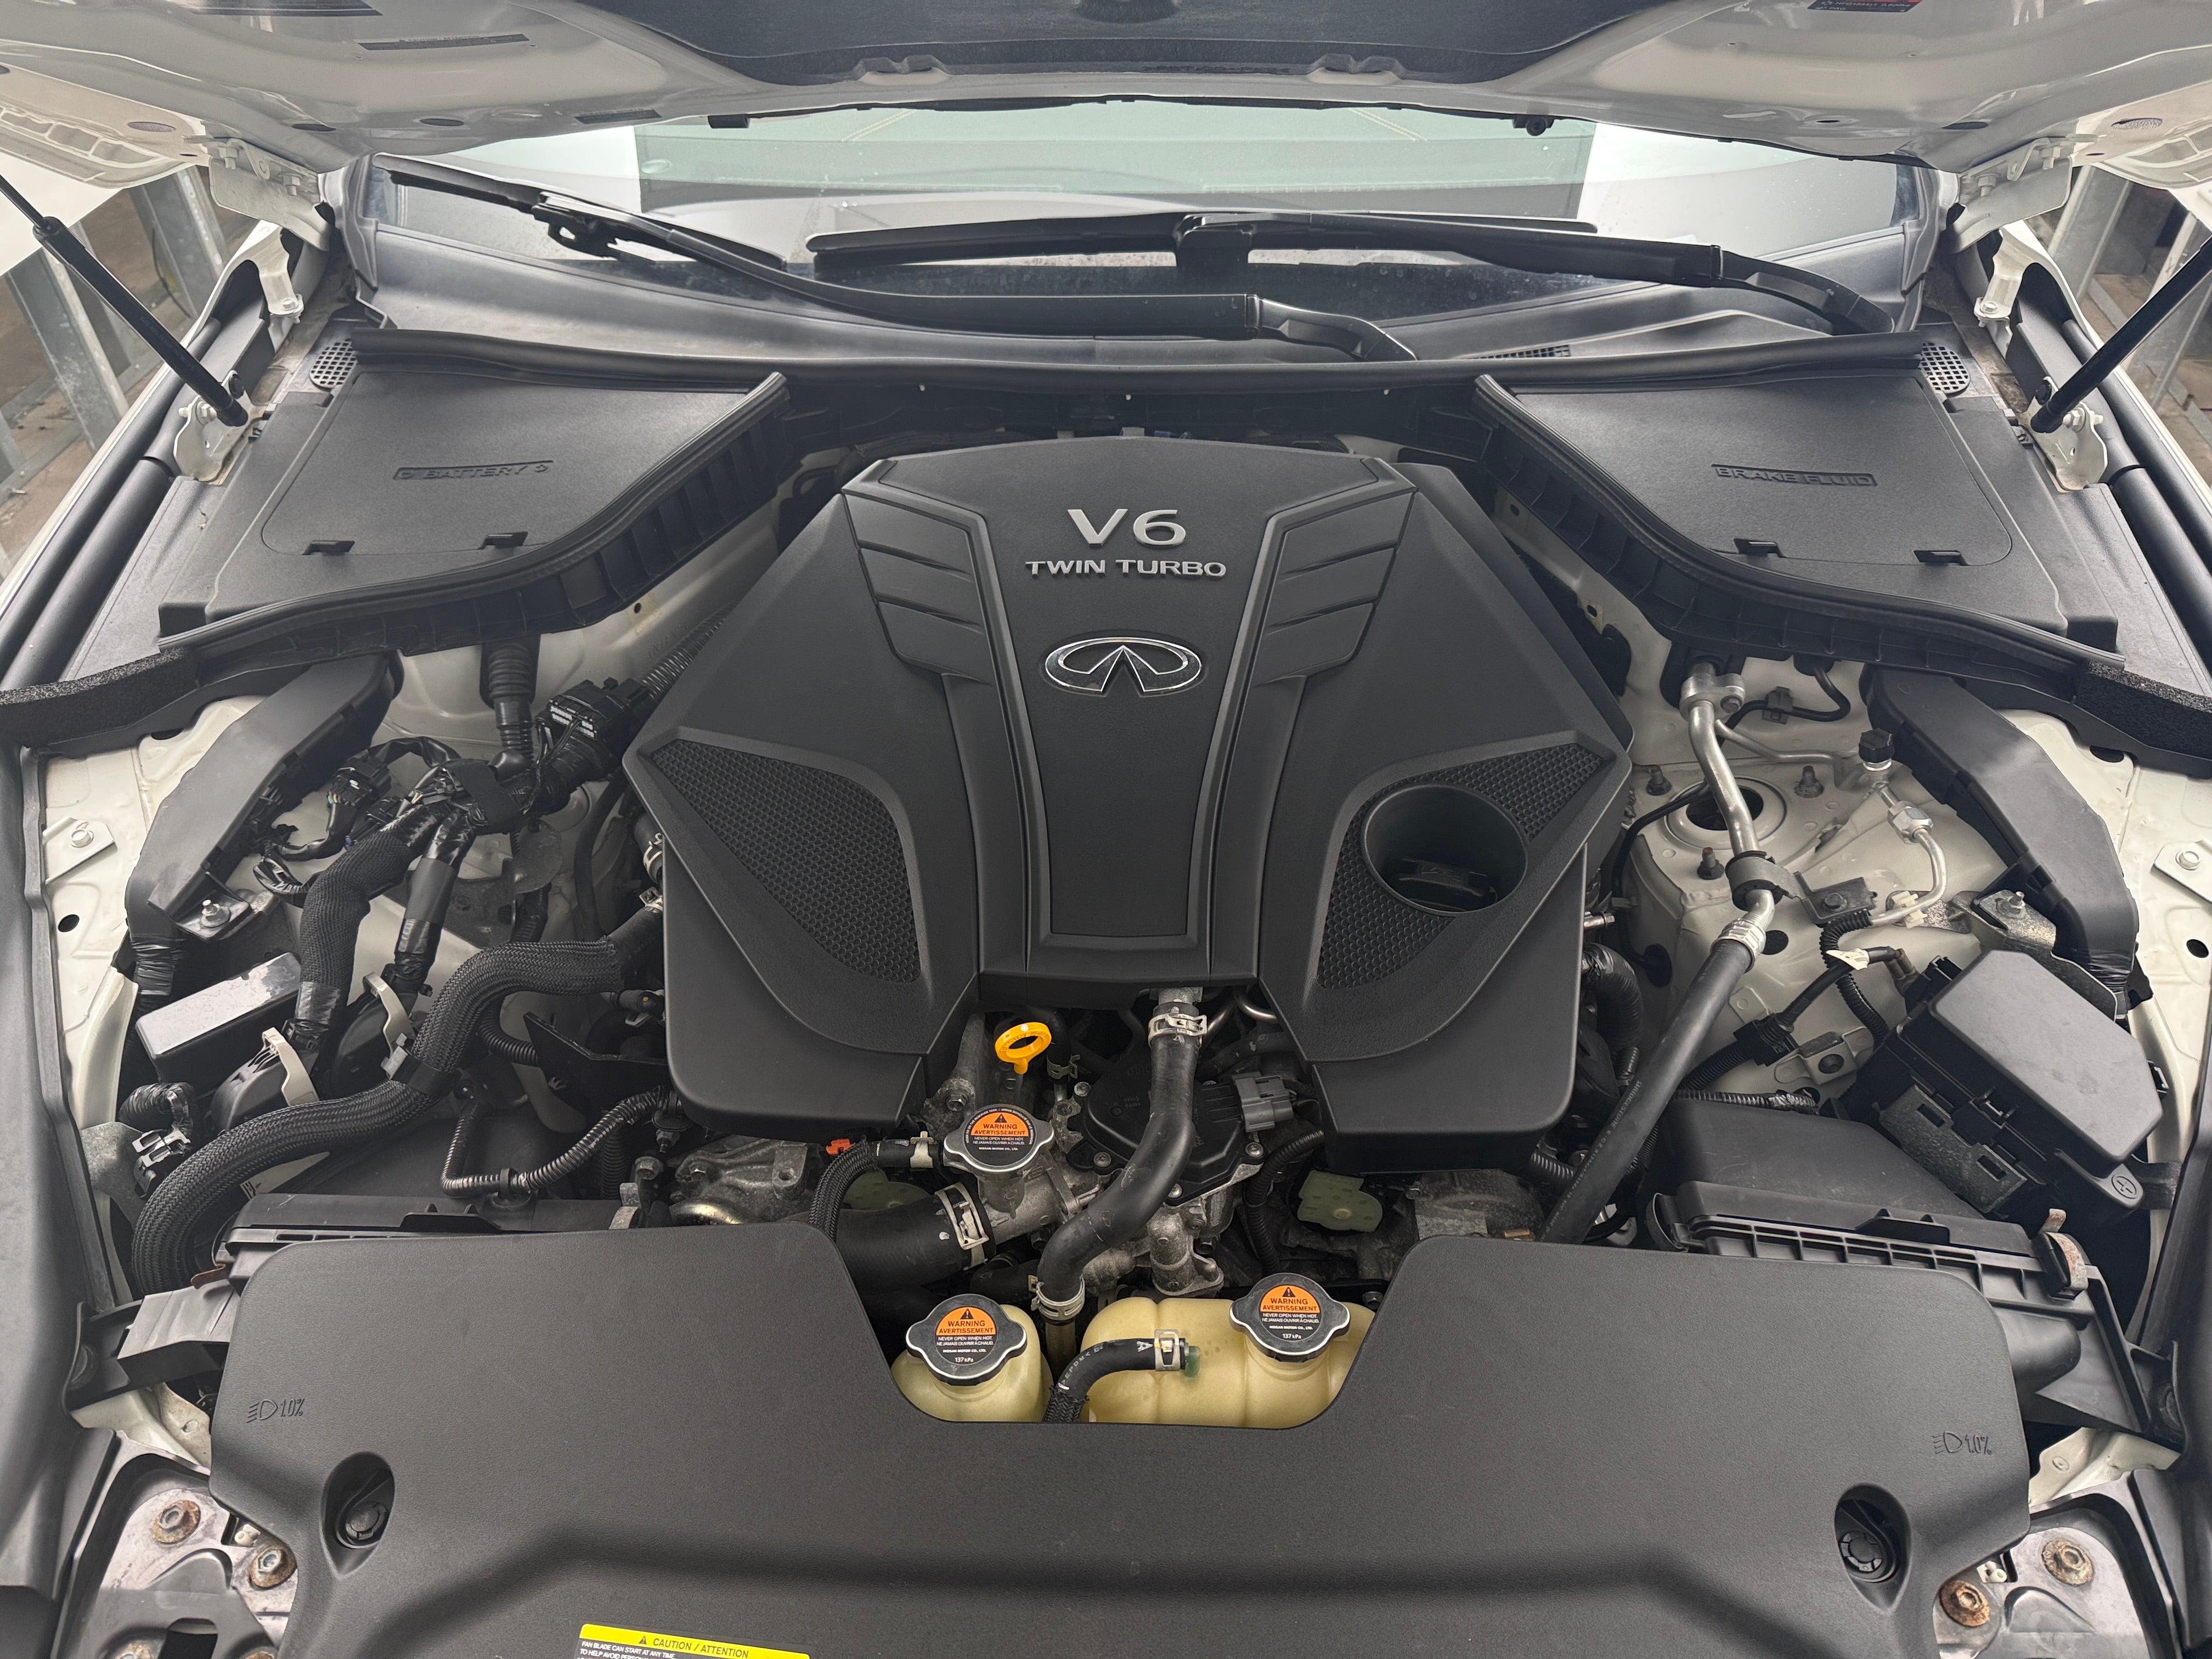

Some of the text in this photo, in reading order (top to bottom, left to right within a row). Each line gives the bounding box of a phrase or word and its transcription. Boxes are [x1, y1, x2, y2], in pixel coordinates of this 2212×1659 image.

[423, 465, 528, 479] BATTERY
[1715, 467, 1872, 486] BRAKE FLUID
[1068, 509, 1186, 547] V6
[1025, 559, 1227, 578] TWIN TURBO
[280, 1398, 305, 1417] 1.0%
[1965, 1434, 1992, 1455] 1.0%
[593, 1642, 612, 1651] BLADE
[624, 1646, 642, 1655] START
[653, 1637, 692, 1651] CAUTION
[700, 1646, 749, 1658] ATTENTION
